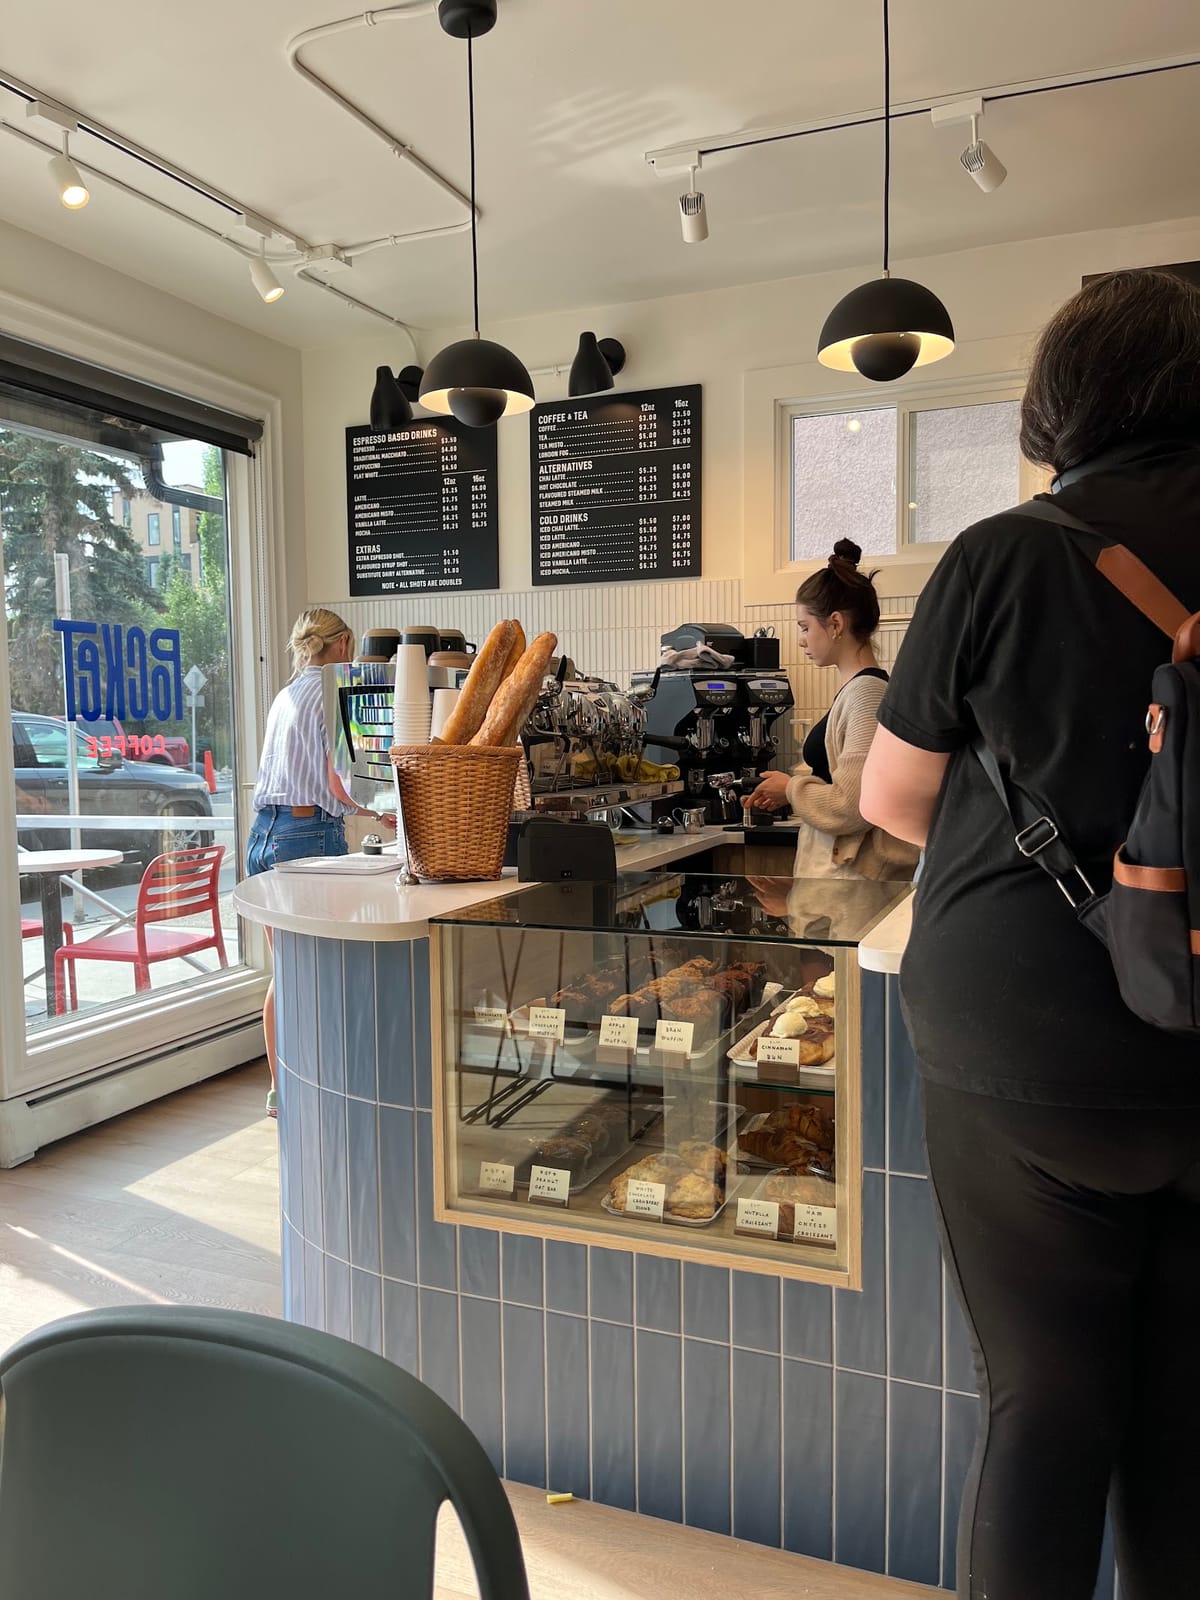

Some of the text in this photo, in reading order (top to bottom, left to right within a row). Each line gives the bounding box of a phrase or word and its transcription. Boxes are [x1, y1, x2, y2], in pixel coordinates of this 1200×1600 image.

[538, 413, 566, 424] COFFEE
[574, 410, 588, 420] TEA
[672, 410, 690, 418] $3.50
[353, 428, 437, 446] ESPRESSO BASED DRINKS
[353, 445, 375, 454] ESPRESSO
[539, 460, 593, 474] ALTERNATIVES
[550, 481, 577, 489] CHOCOLATE
[568, 489, 590, 497] STEAMED
[540, 512, 588, 525] COLD DRINKS
[356, 544, 381, 554] EXTRAS
[552, 541, 580, 549] AMERICANO
[399, 581, 408, 589] ALL
[410, 580, 426, 588] SHOTS
[427, 579, 438, 587] ARE
[439, 578, 462, 586] DOUBLES
